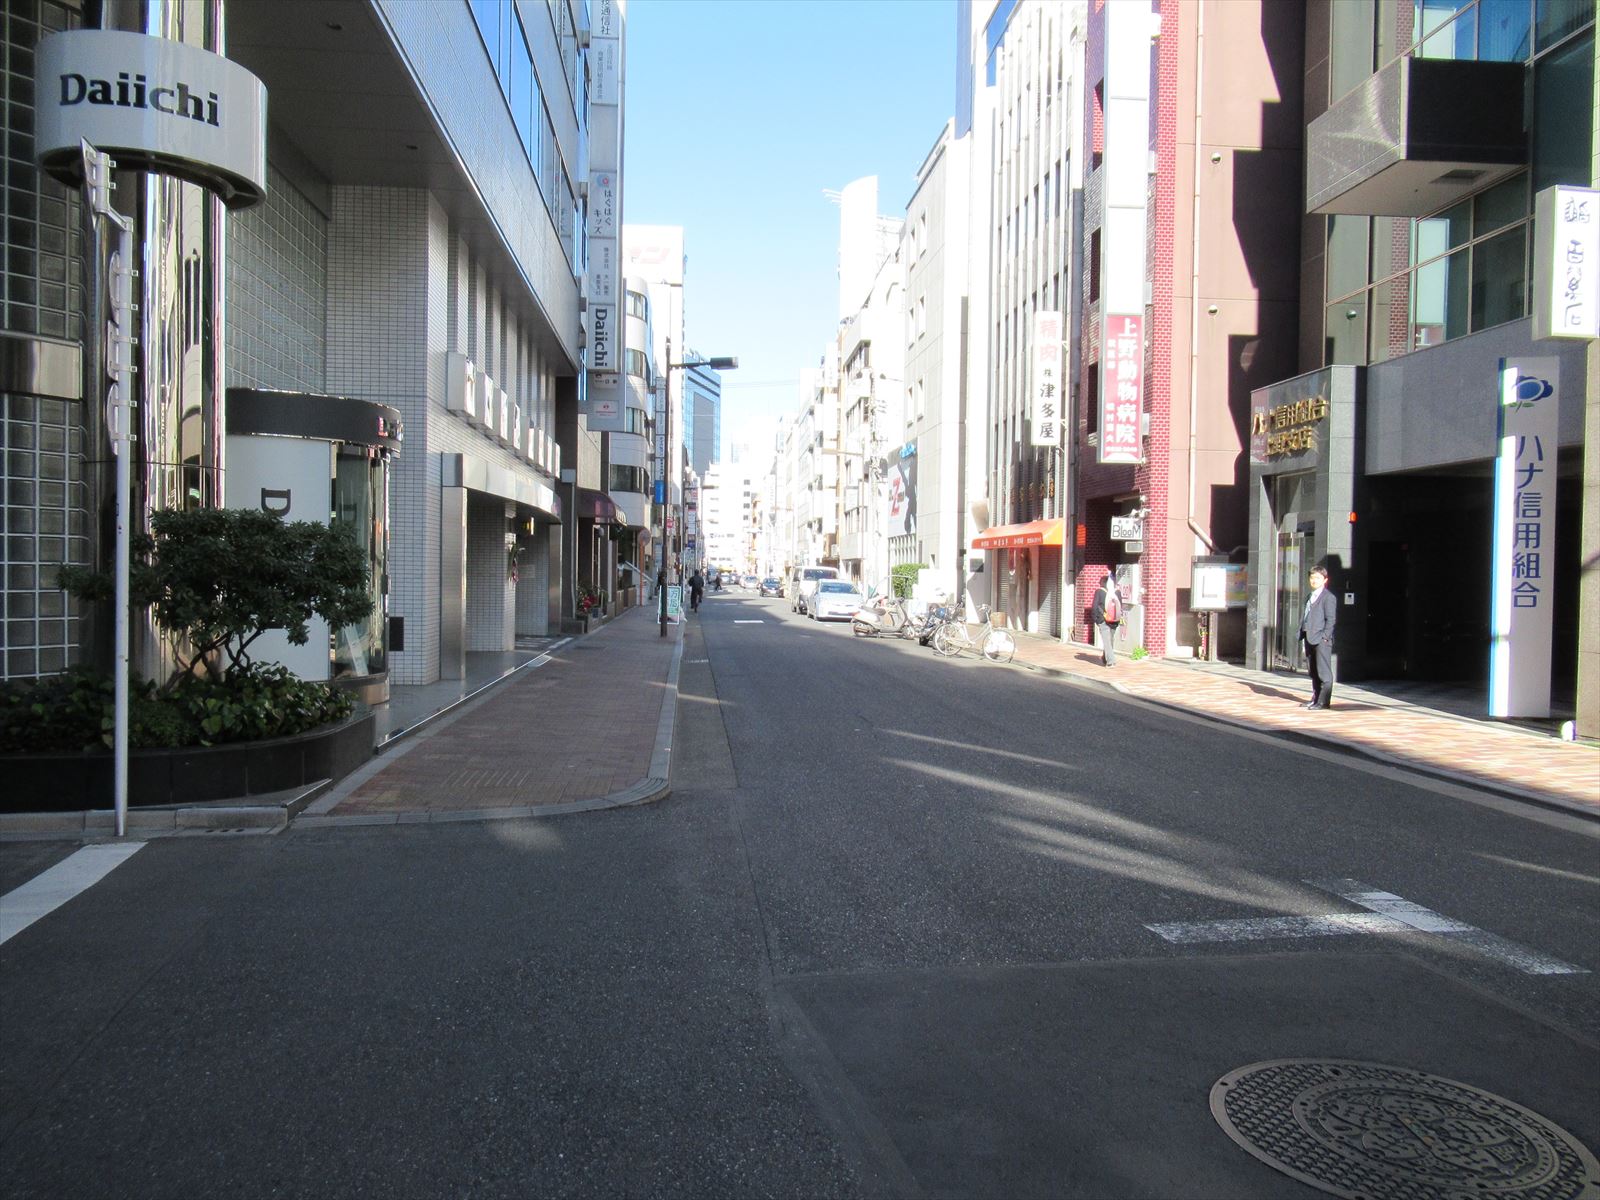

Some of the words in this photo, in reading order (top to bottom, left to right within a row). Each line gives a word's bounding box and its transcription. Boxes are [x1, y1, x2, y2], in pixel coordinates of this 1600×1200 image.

[59, 72, 220, 127] Daiichi
[594, 208, 603, 234] キッズ
[604, 190, 612, 226] はぐはぐ
[594, 308, 608, 367] Daiichi
[1116, 317, 1138, 443] 上野動物病院
[1039, 383, 1055, 438] 津多屋
[1511, 435, 1544, 608] ハナ信用組合
